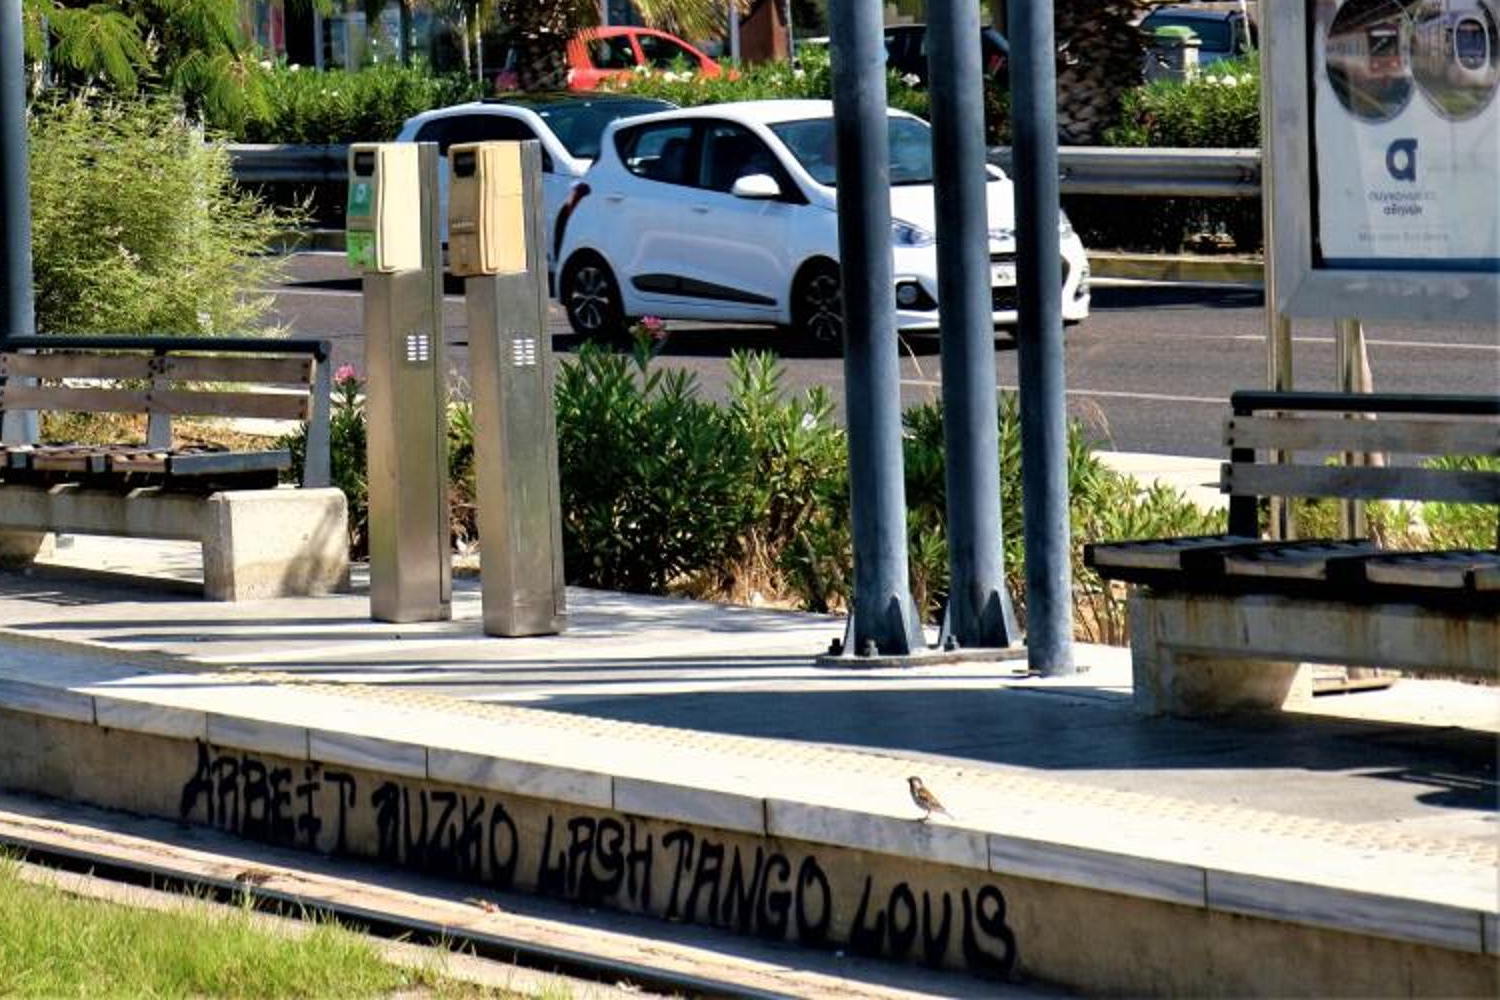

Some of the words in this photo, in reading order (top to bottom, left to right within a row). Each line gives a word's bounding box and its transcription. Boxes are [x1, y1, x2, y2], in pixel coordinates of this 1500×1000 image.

[180, 737, 357, 857] ARBEIT
[662, 828, 833, 945] TANGO
[849, 874, 1016, 974] LOUIS
